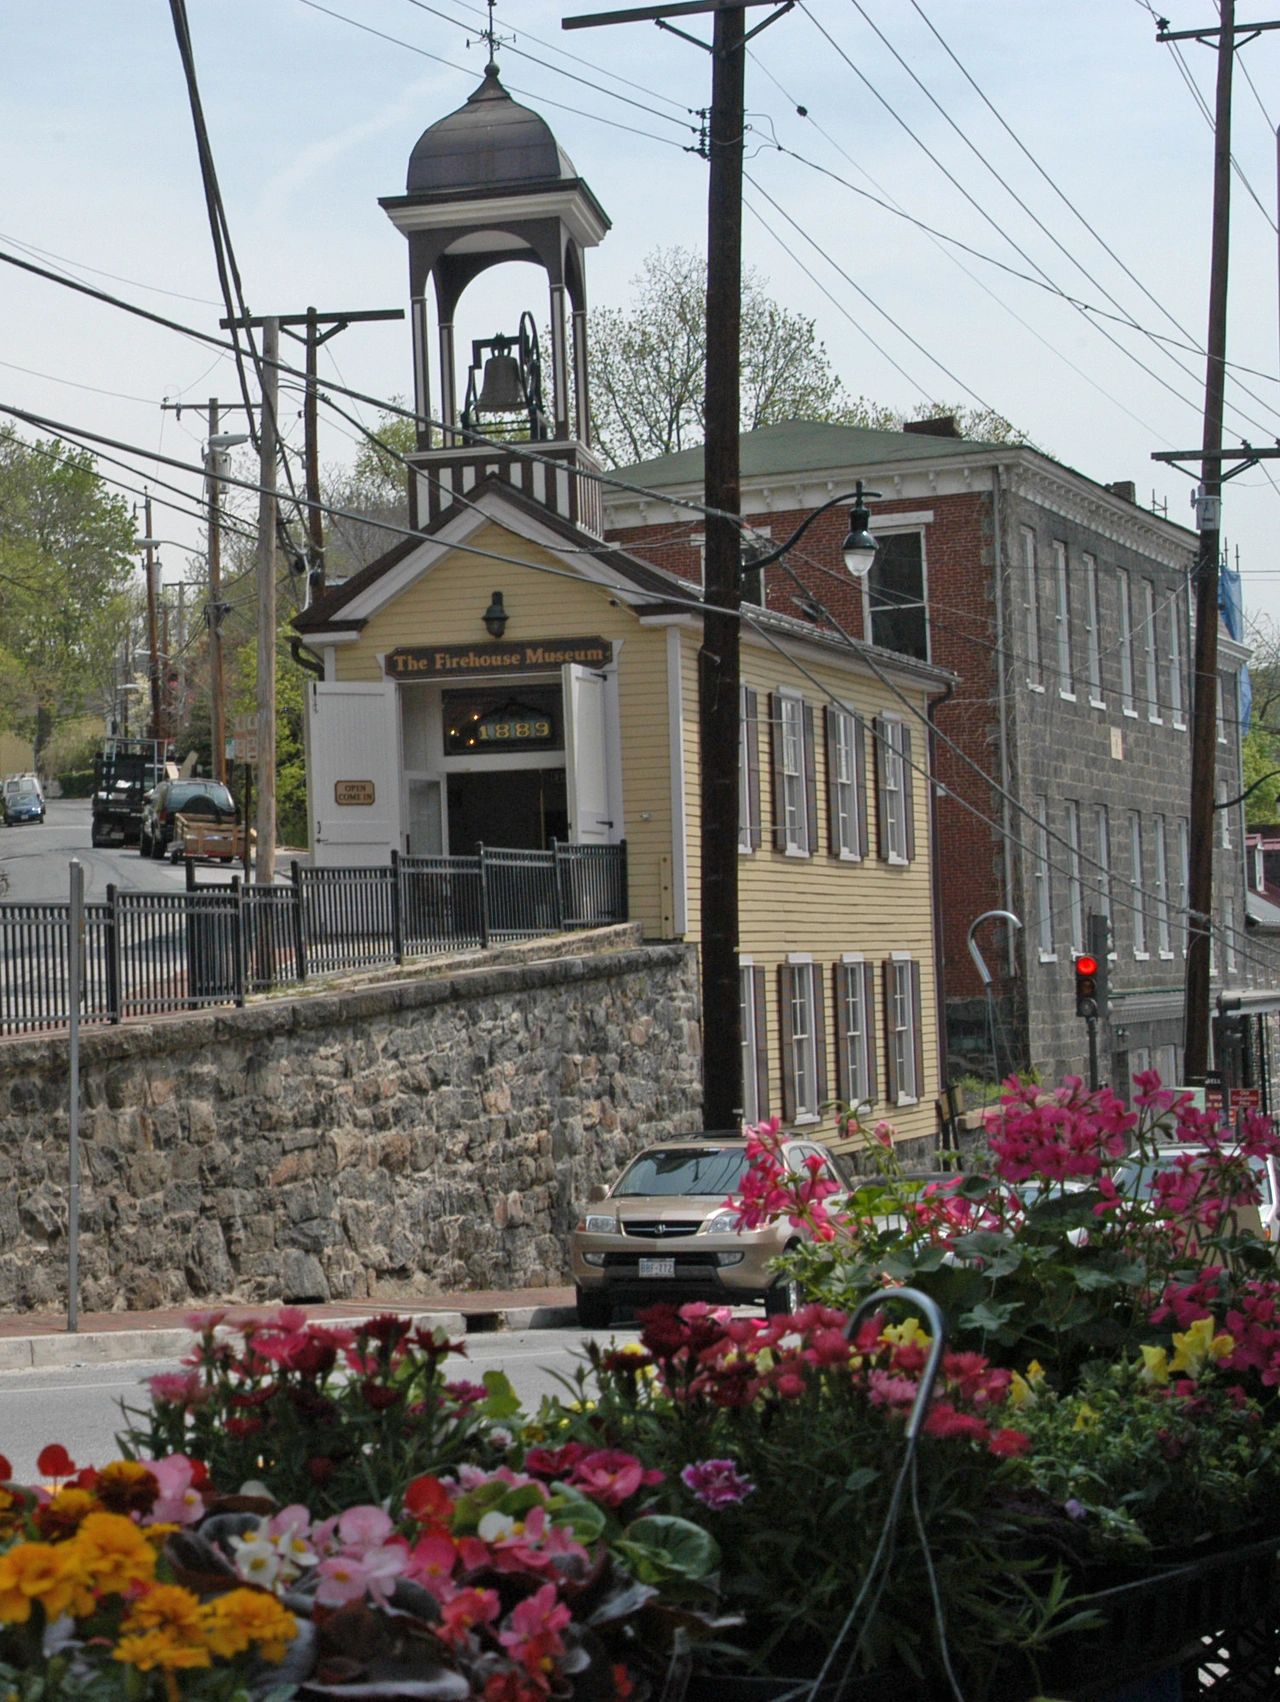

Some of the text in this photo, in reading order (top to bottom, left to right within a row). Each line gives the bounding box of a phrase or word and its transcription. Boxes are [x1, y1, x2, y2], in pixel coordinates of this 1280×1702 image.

[394, 648, 603, 671] The Firehouse Museum
[479, 722, 551, 739] 1889
